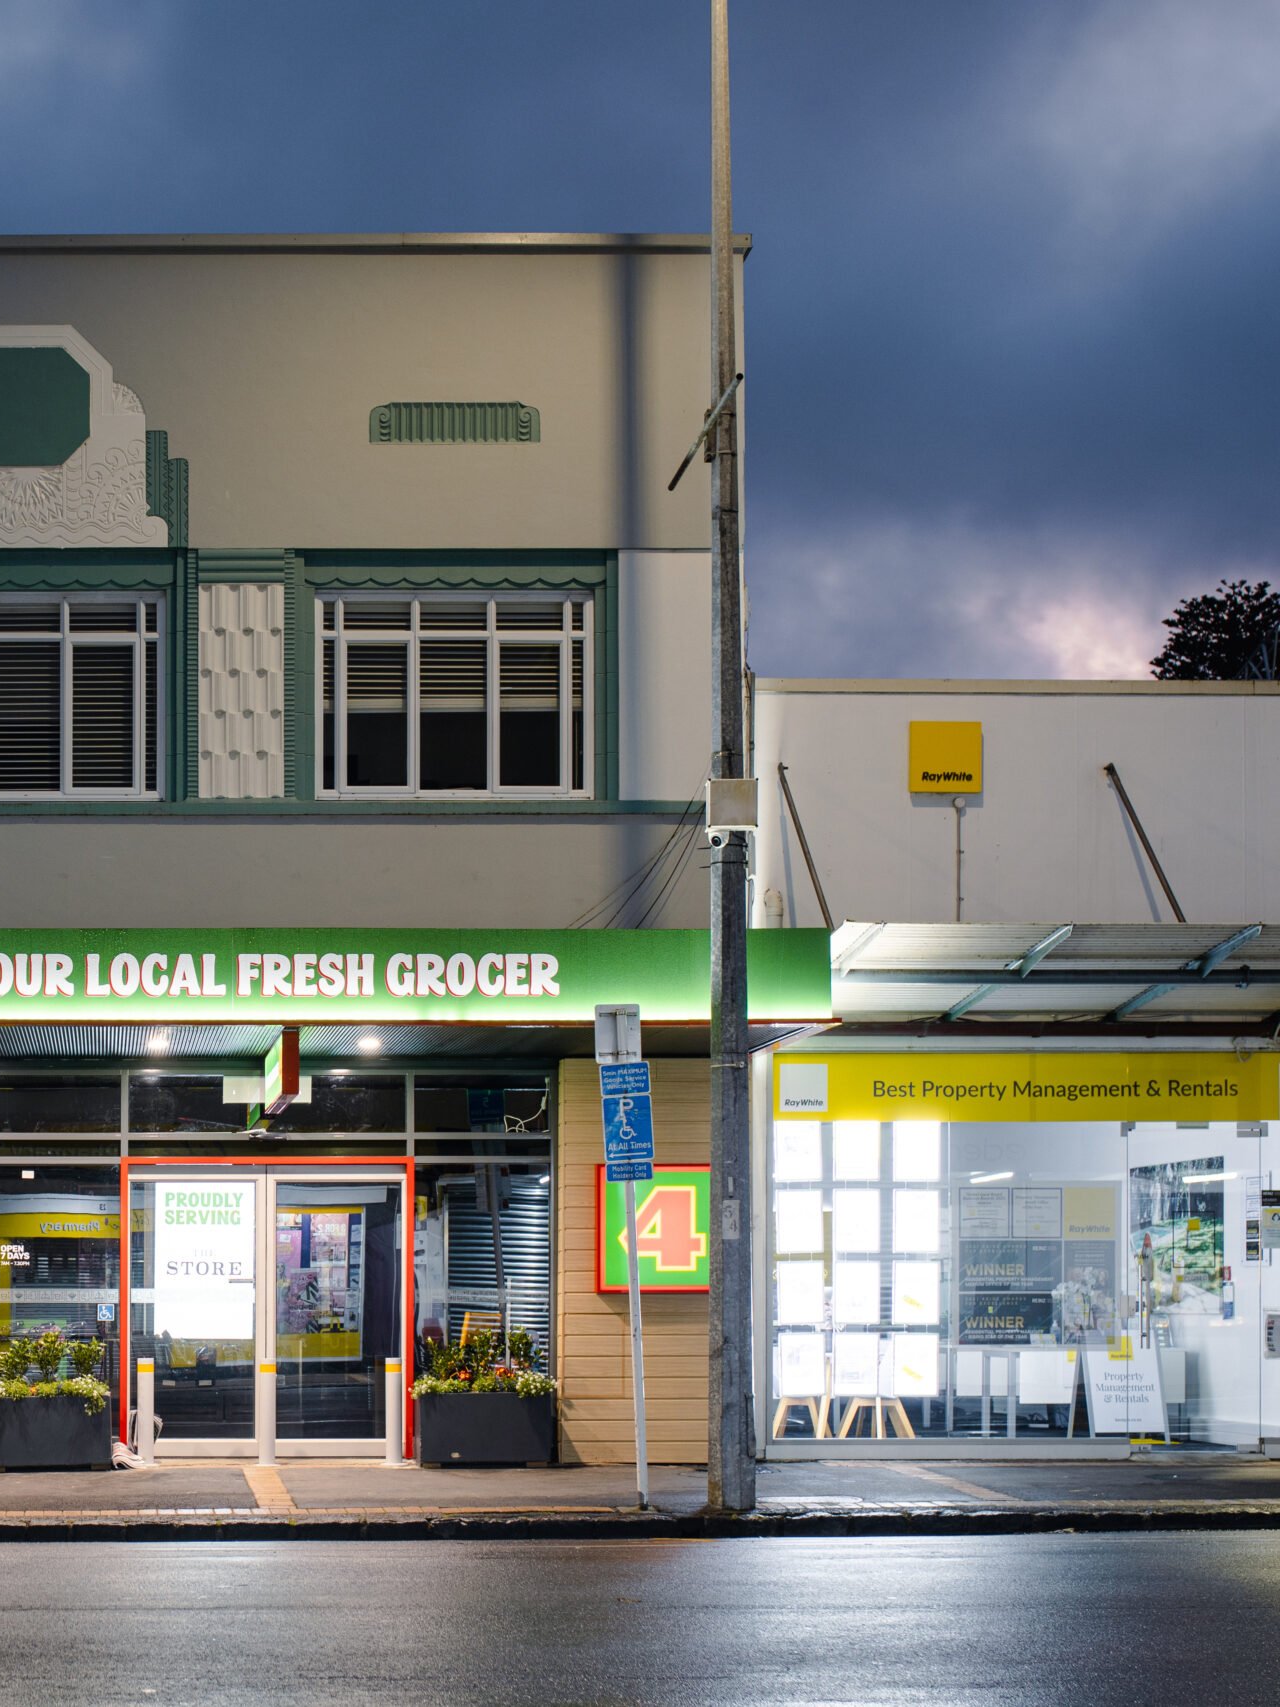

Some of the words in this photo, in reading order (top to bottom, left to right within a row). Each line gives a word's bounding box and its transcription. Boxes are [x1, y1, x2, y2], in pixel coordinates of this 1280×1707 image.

[85, 953, 226, 997] LOCAL
[236, 953, 375, 997] FRESH
[385, 953, 560, 997] GROCER
[632, 1081, 645, 1089] Only
[873, 1080, 916, 1098] Best
[922, 1080, 1007, 1101] Property
[1013, 1080, 1140, 1101] Management
[1146, 1080, 1161, 1097] &
[1169, 1079, 1239, 1097] Rentals
[620, 1098, 634, 1114] P
[608, 1143, 618, 1151] At
[618, 1142, 628, 1150] All
[630, 1141, 652, 1149] Times
[612, 1165, 633, 1173] Mobility
[165, 1192, 243, 1208] PROUDLY
[165, 1210, 241, 1225] SERVING
[617, 1185, 707, 1272] 4
[0, 1244, 24, 1253] OPEN
[0, 1252, 6, 1260] 7
[7, 1252, 30, 1260] DAYS
[166, 1260, 242, 1276] STORE
[965, 1264, 1025, 1276] WINNER
[965, 1316, 1025, 1329] WINNER
[1104, 1372, 1144, 1382] Property
[1095, 1384, 1155, 1393] Management
[1103, 1393, 1113, 1403] &
[1115, 1394, 1150, 1403] Rentals
